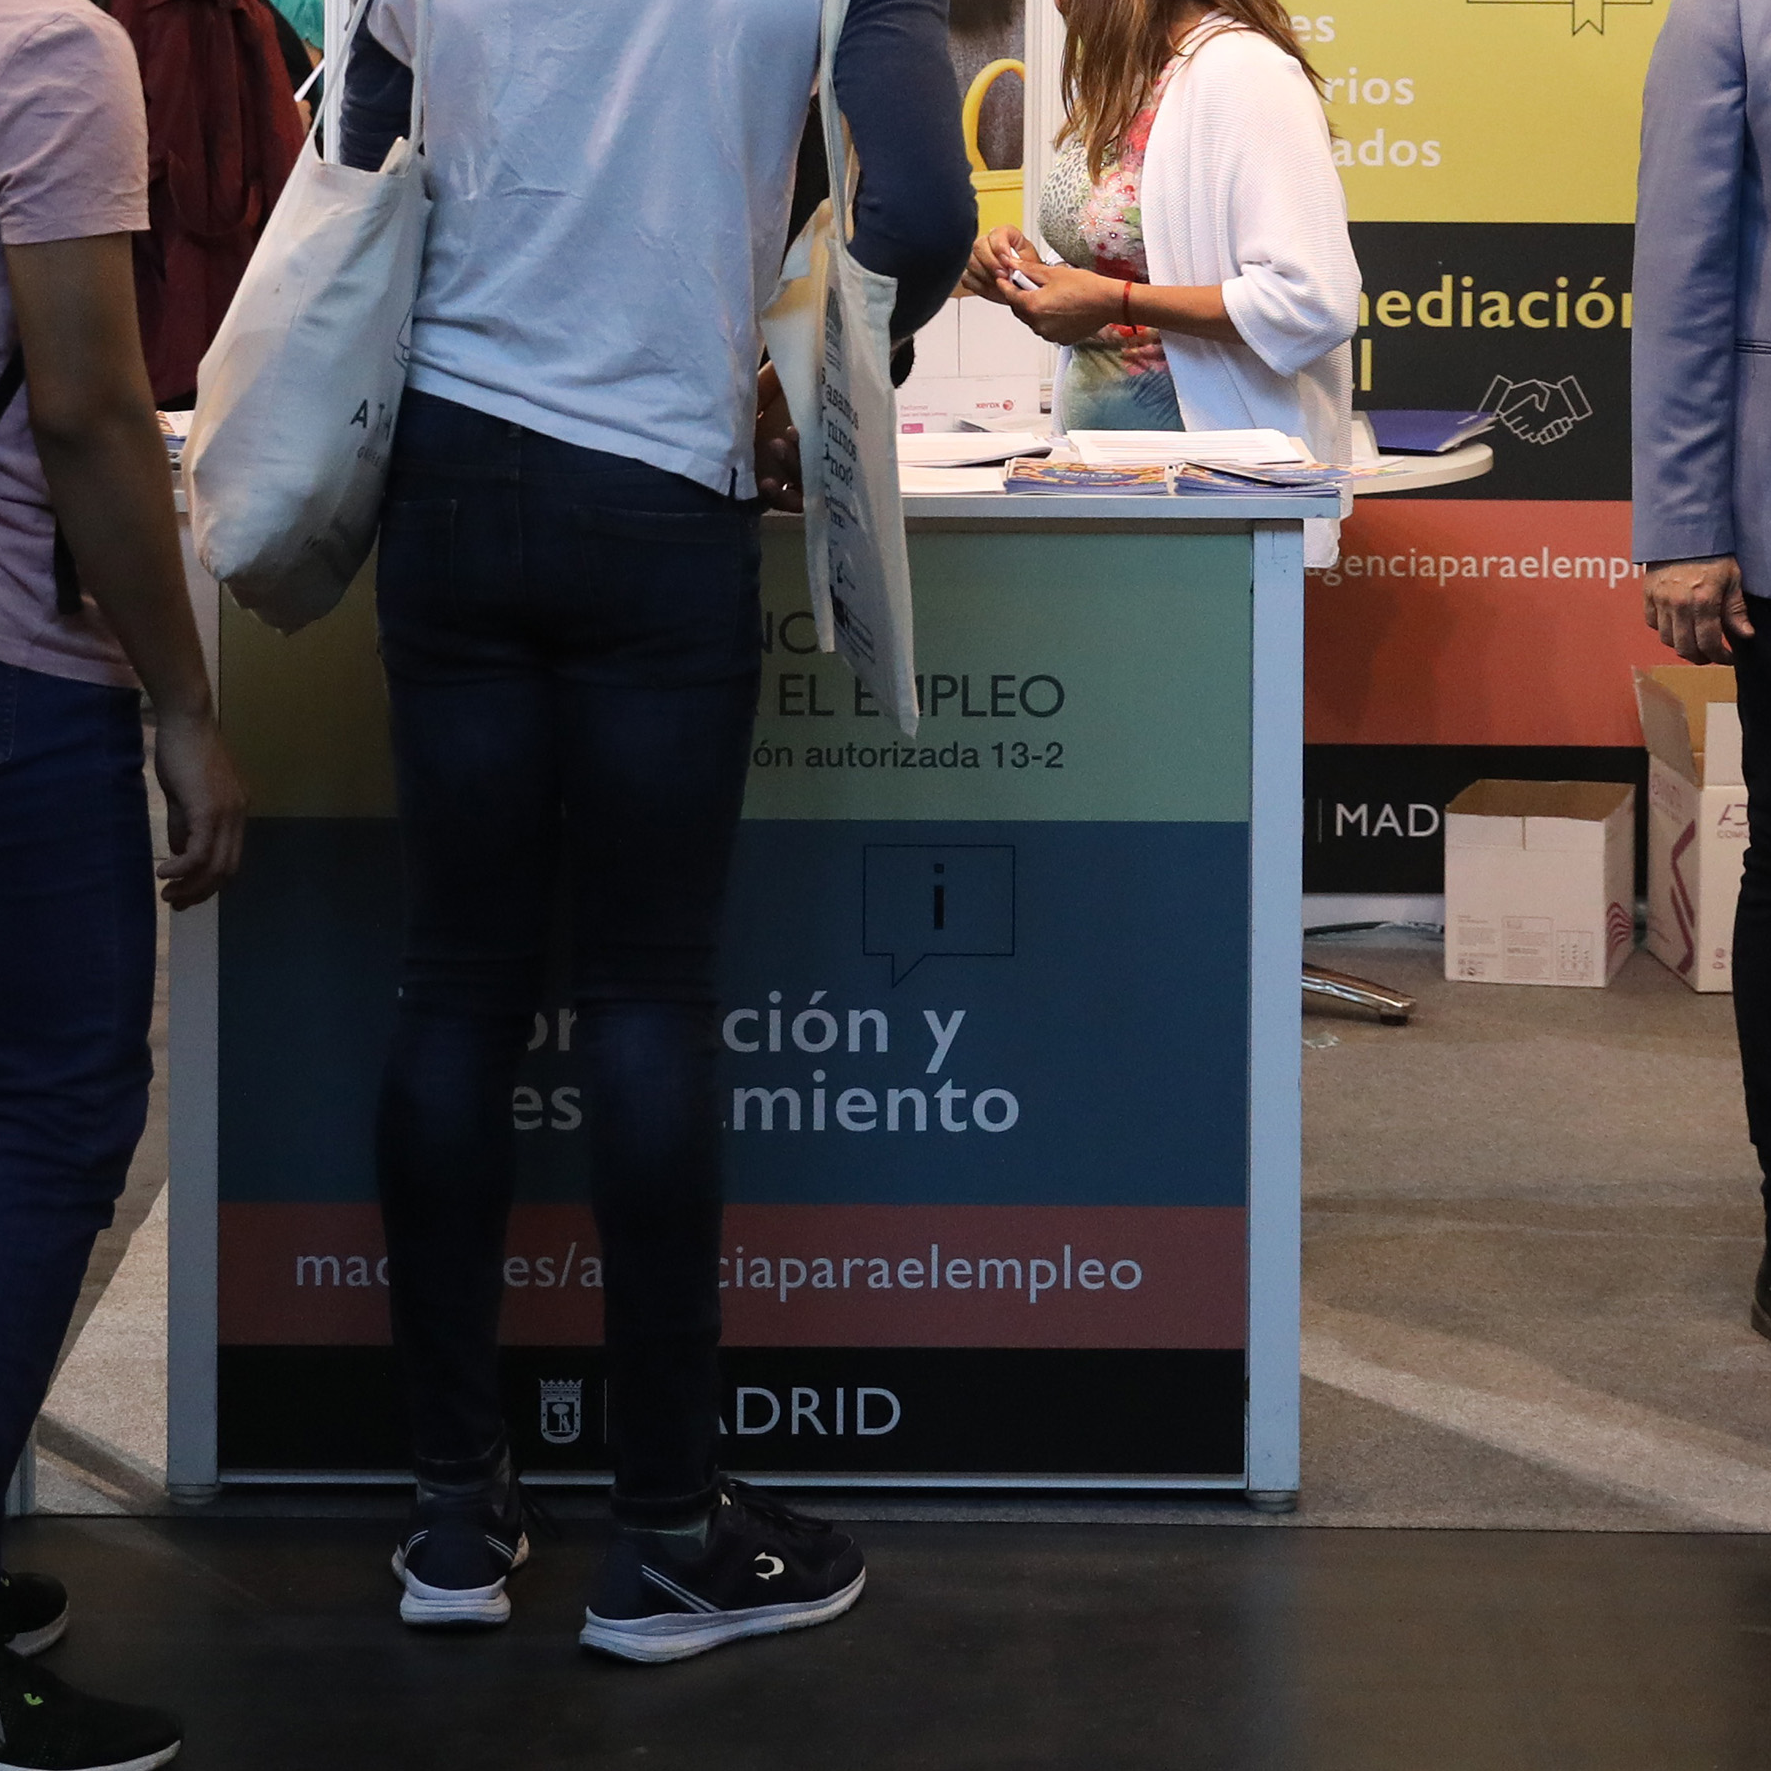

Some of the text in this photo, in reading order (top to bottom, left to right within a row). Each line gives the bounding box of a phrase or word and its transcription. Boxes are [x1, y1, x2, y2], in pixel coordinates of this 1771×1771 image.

[975, 402, 1001, 410] xerox
[778, 674, 835, 717] EL
[804, 740, 981, 770] autorizada
[990, 740, 1065, 770] 13-2
[922, 1009, 967, 1075] y
